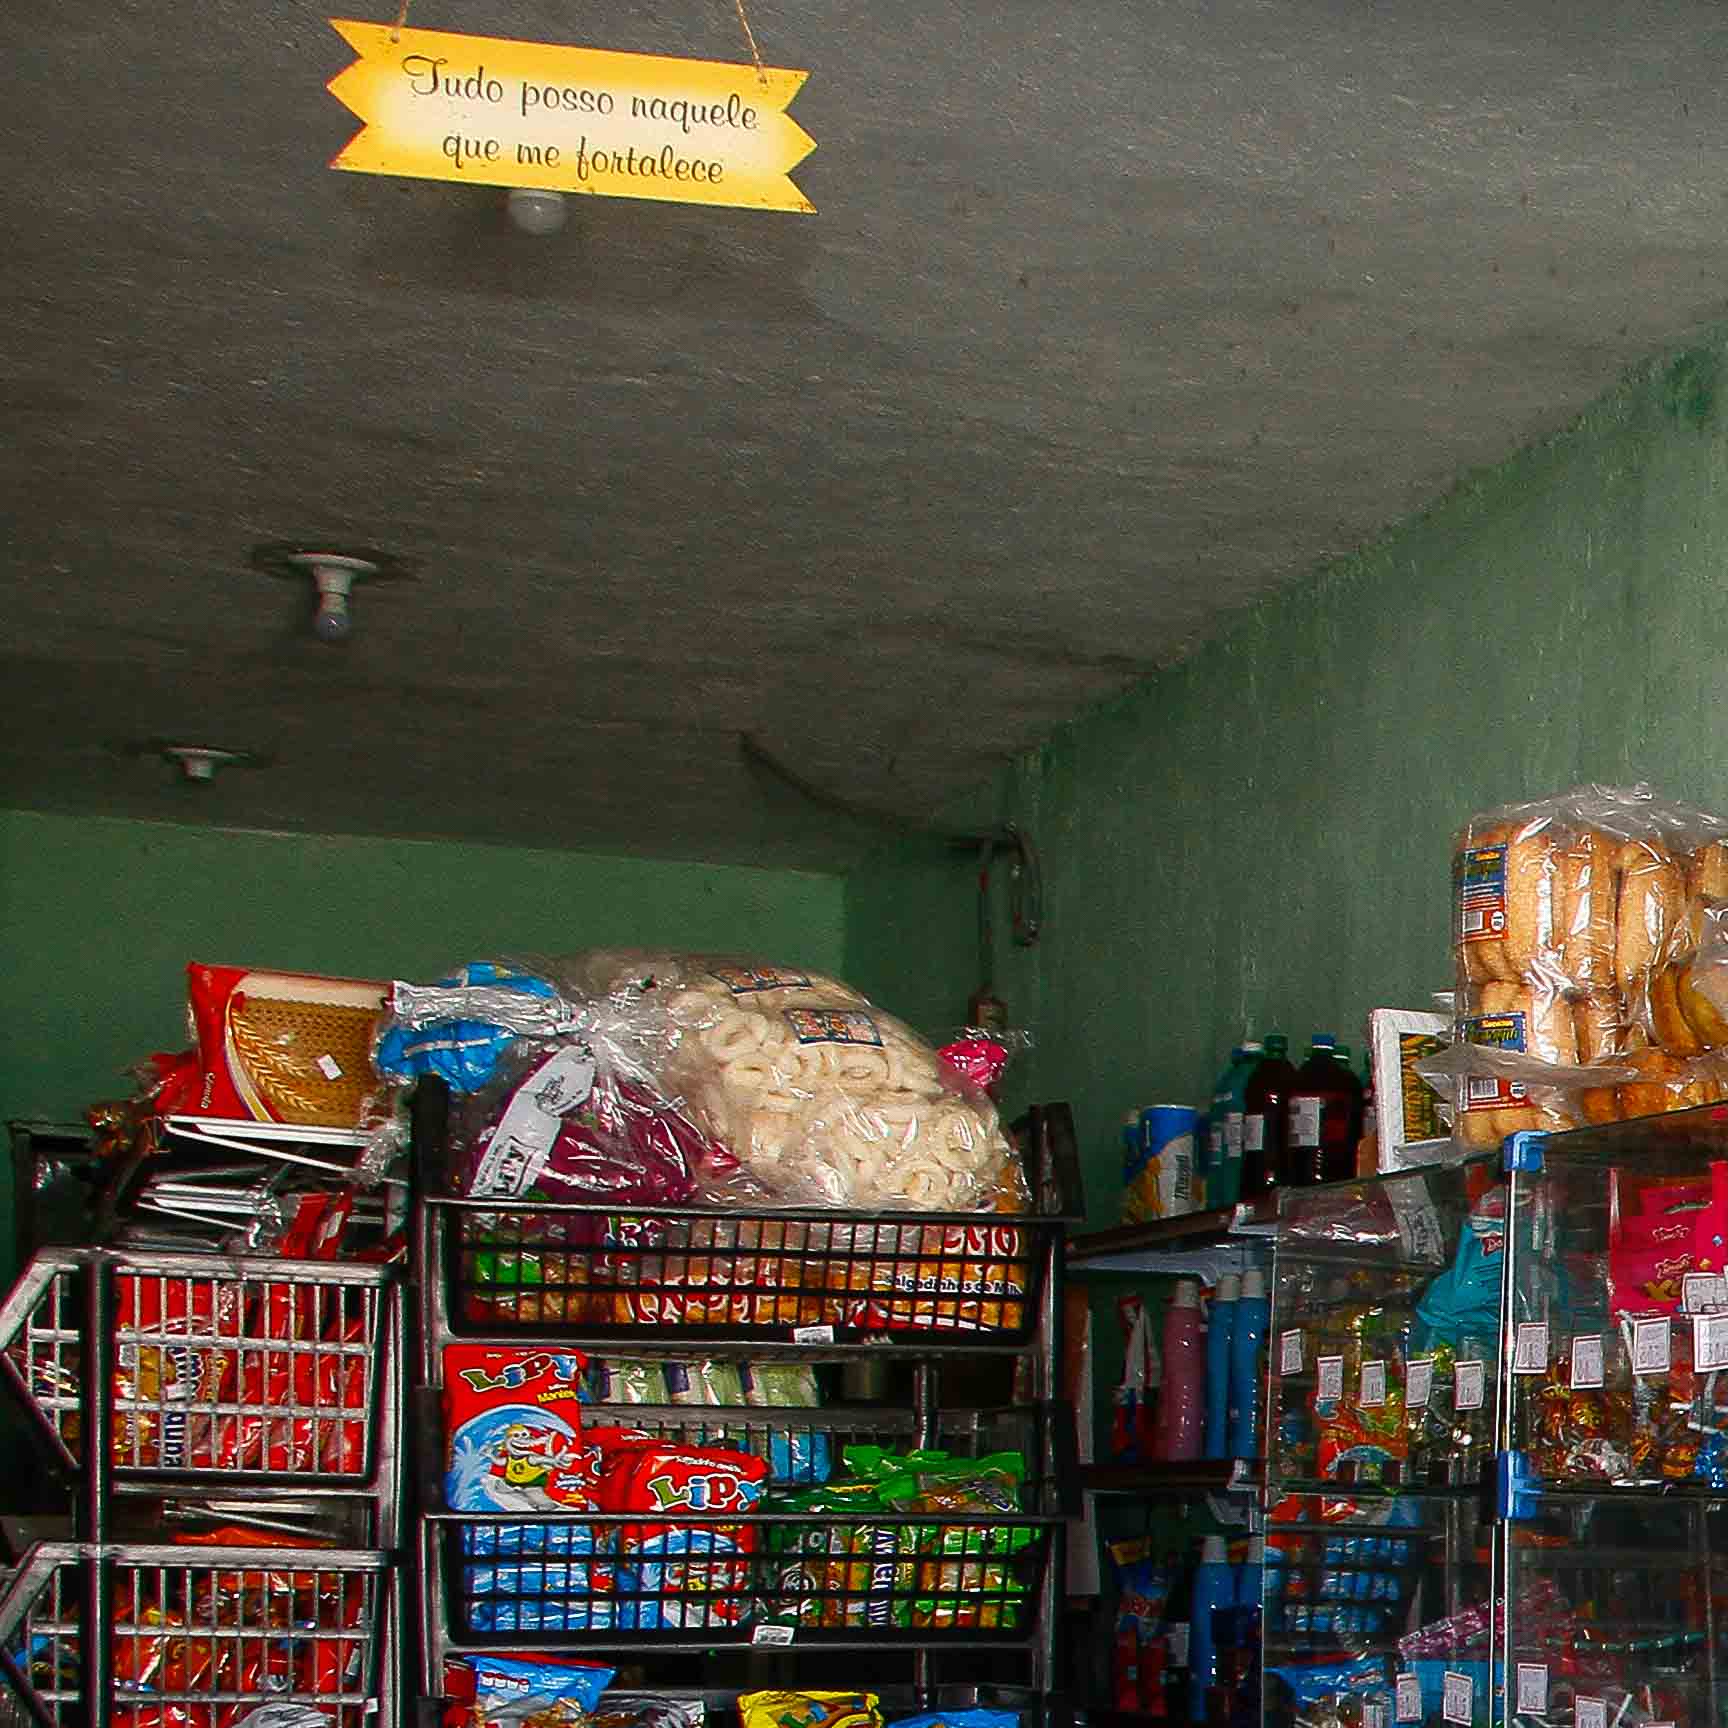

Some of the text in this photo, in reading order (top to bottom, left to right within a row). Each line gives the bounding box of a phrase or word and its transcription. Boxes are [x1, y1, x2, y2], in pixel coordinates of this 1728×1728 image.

[402, 55, 757, 134] Tudo posso naquele
[442, 133, 723, 184] que me fortalece
